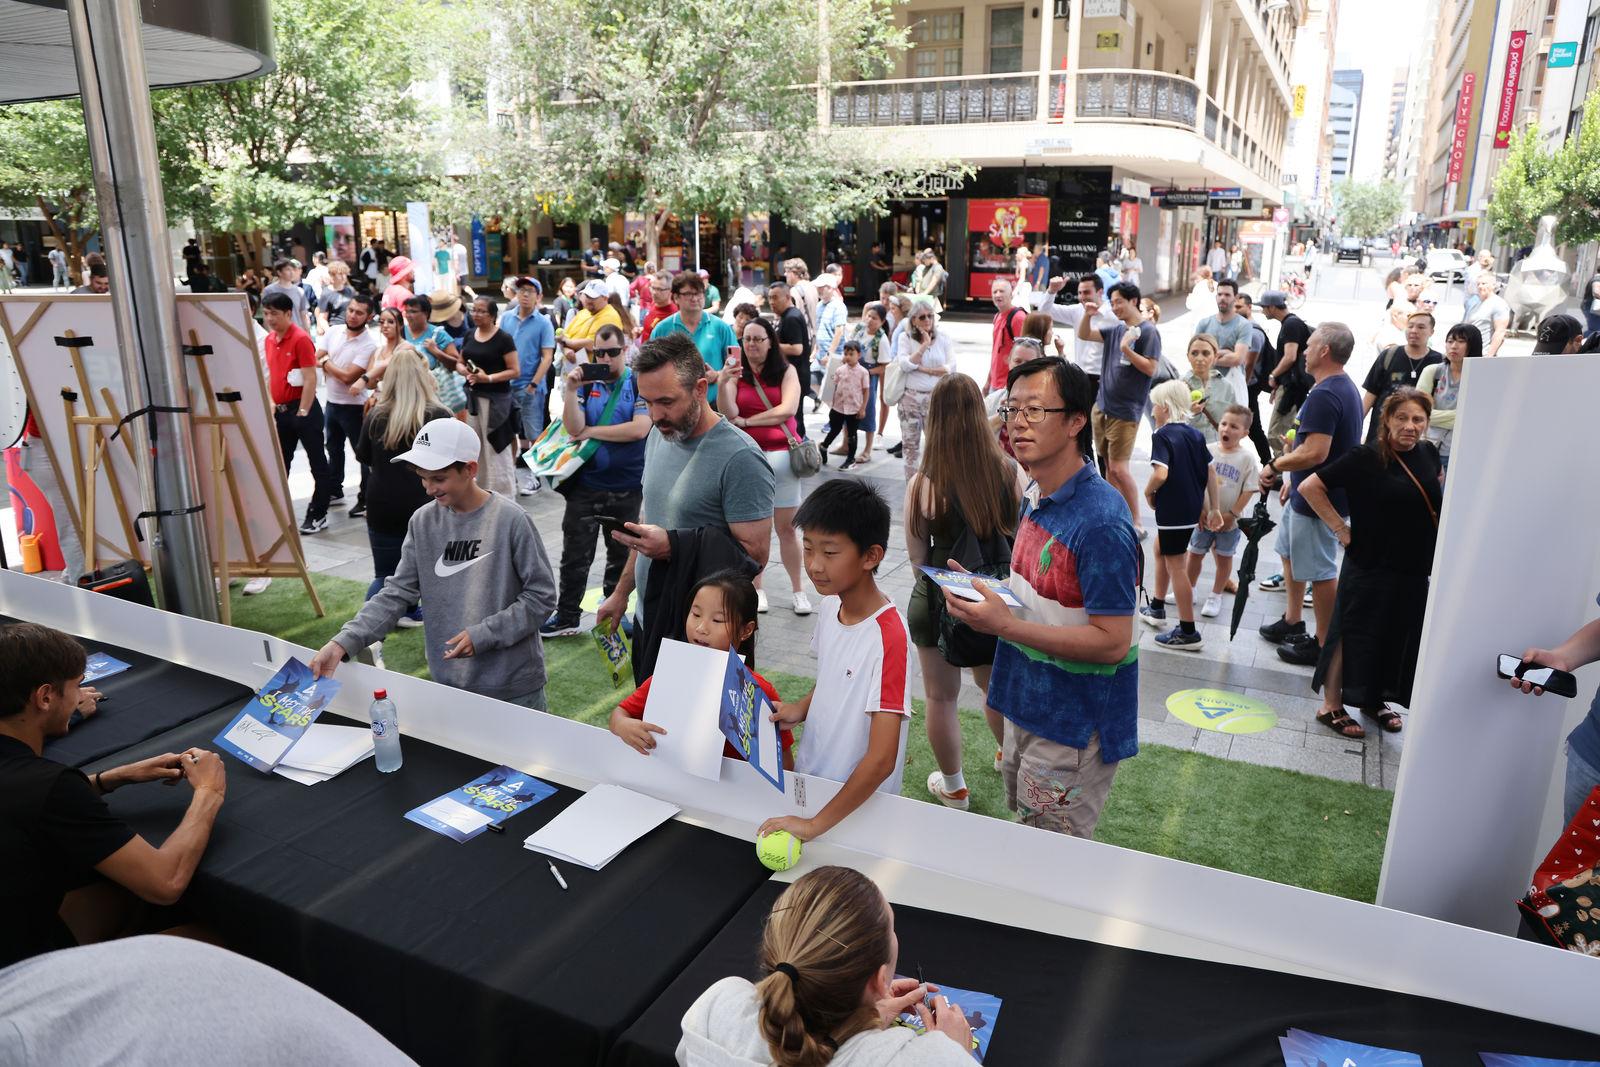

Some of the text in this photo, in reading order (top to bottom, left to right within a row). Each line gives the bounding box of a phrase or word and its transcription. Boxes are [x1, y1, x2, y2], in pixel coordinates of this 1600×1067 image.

[1461, 74, 1473, 116] CITY
[1499, 52, 1519, 126] priceline pharmacy
[1451, 129, 1465, 181] CROSS
[989, 224, 1024, 238] SALE
[473, 239, 482, 274] OPTUS
[1216, 462, 1240, 483] KERS
[444, 539, 482, 561] NIKE
[260, 694, 312, 727] STARS
[743, 681, 755, 755] STARS
[463, 786, 518, 812] STARS
